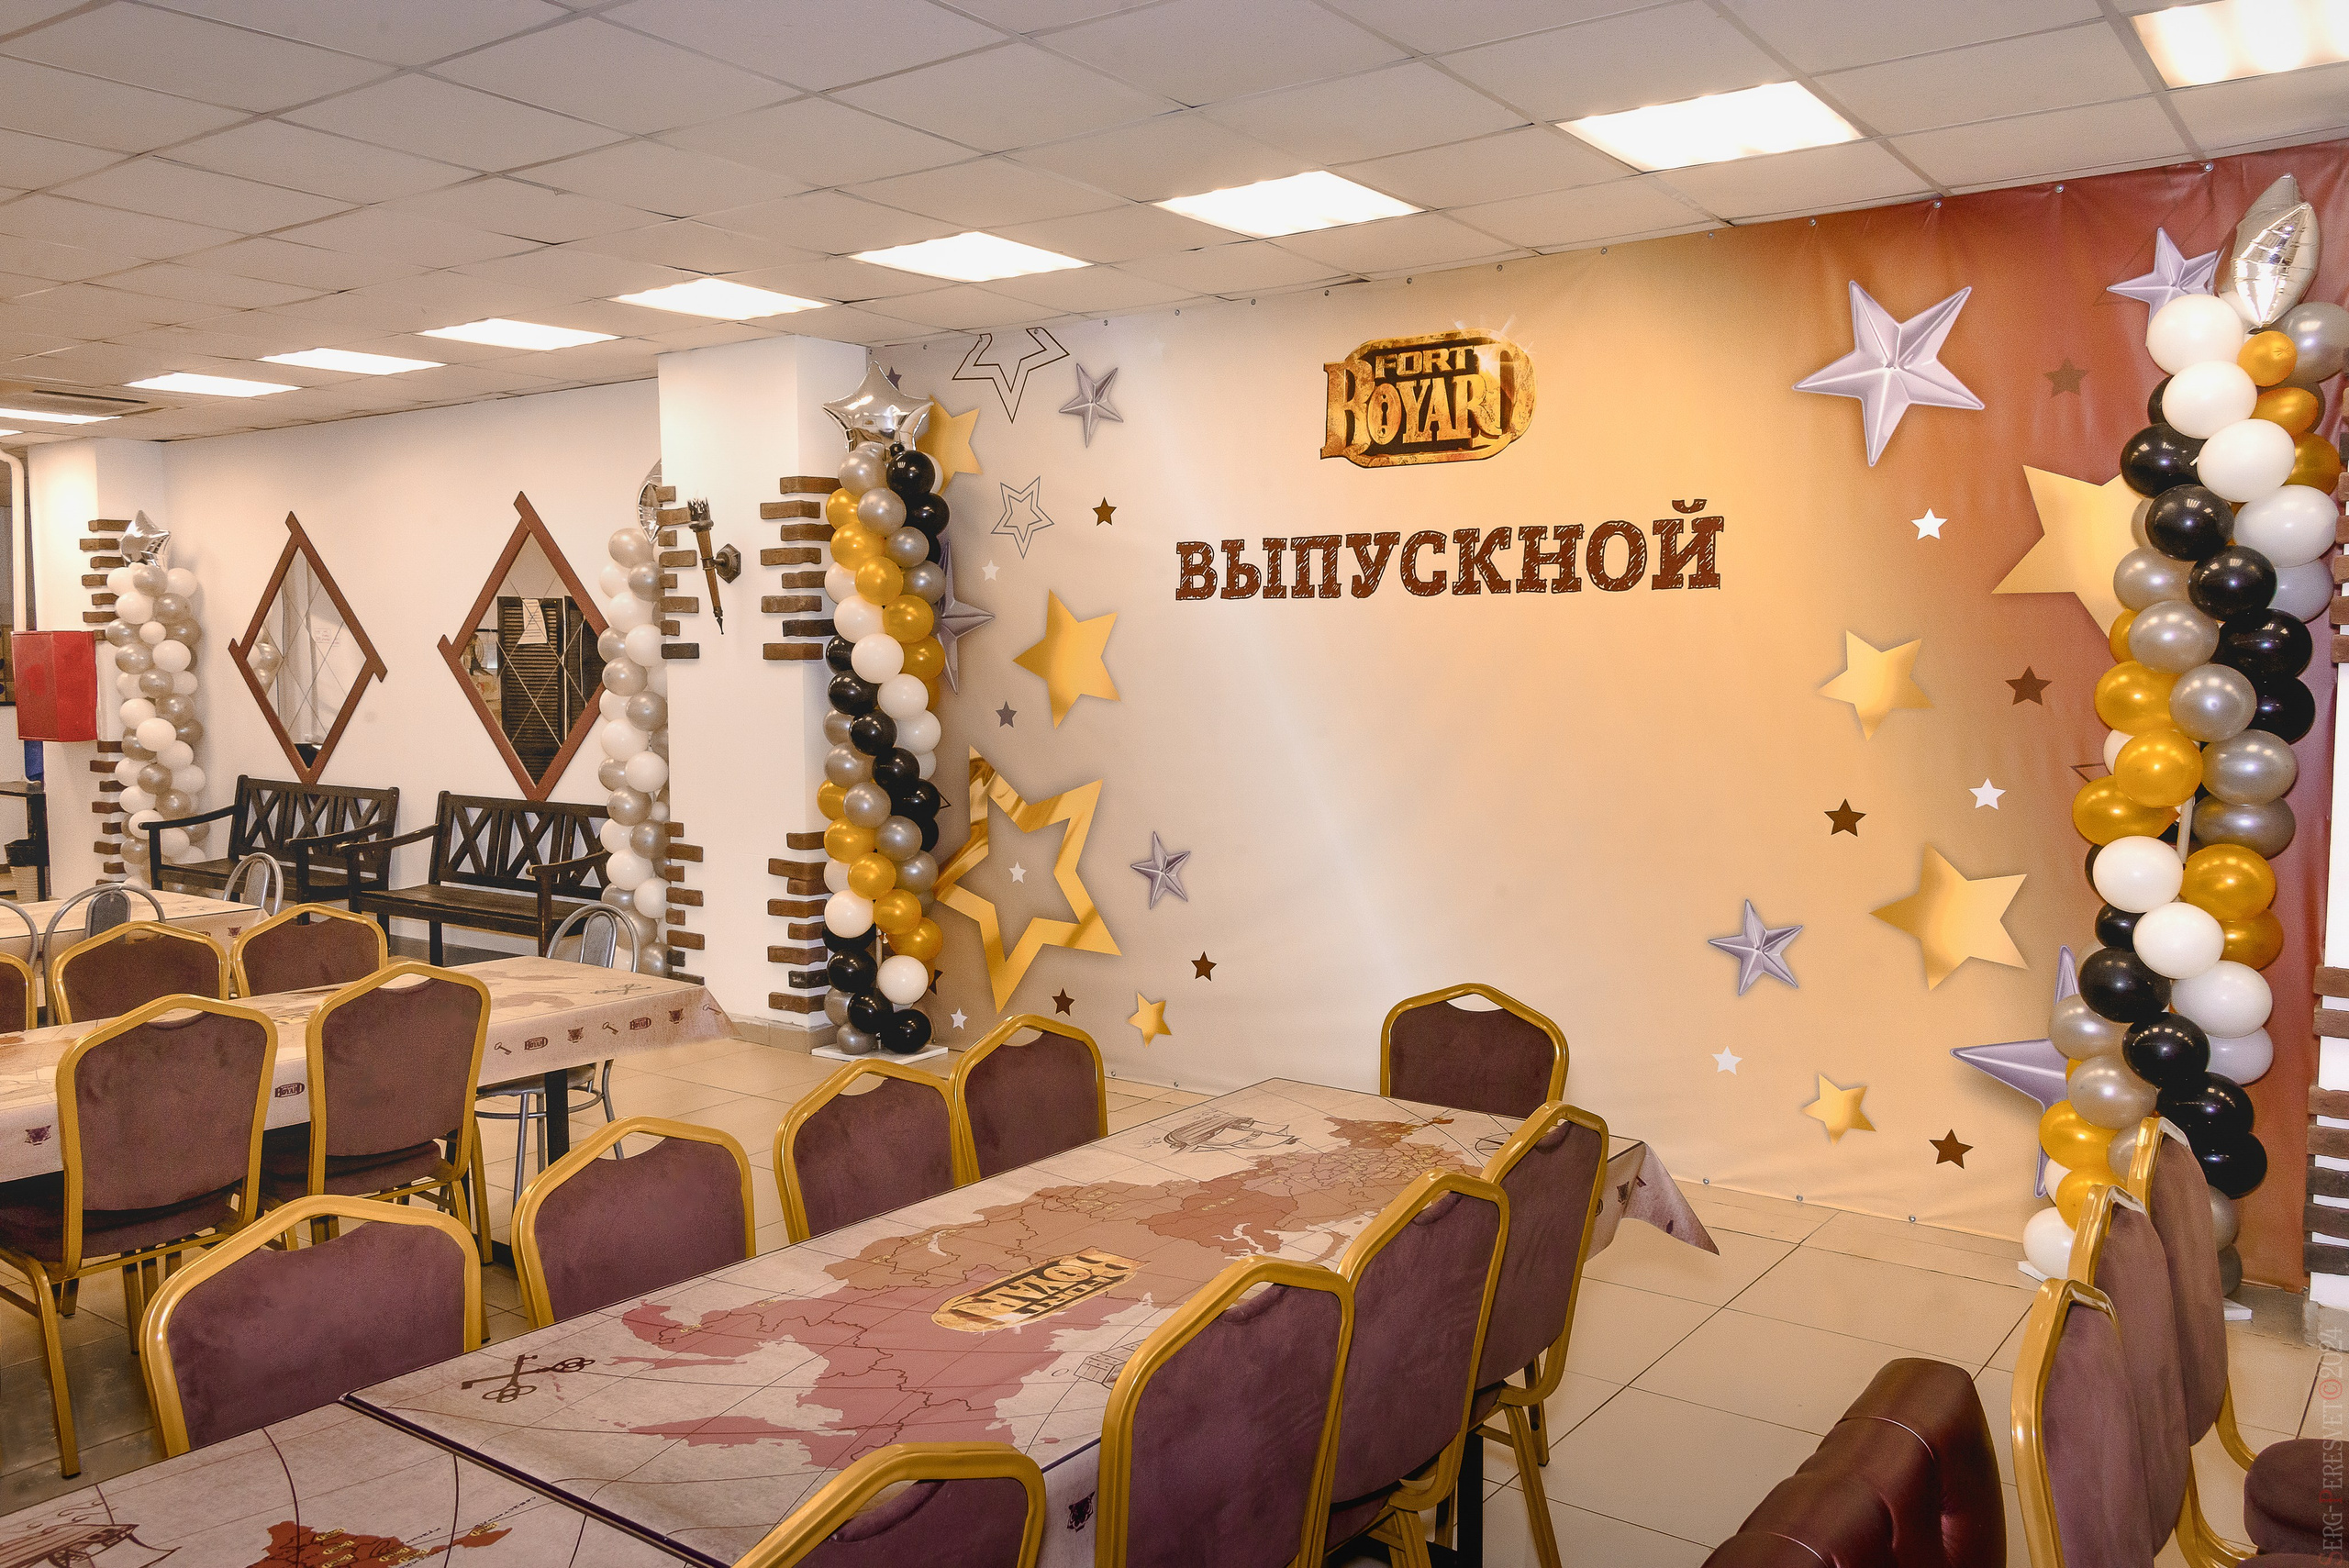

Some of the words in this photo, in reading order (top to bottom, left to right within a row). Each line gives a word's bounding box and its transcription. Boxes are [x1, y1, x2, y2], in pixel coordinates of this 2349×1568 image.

[1319, 340, 1536, 461] BOYARD
[1374, 345, 1475, 379] FORT
[1174, 498, 1725, 601] ВЫПУСКНОЙ
